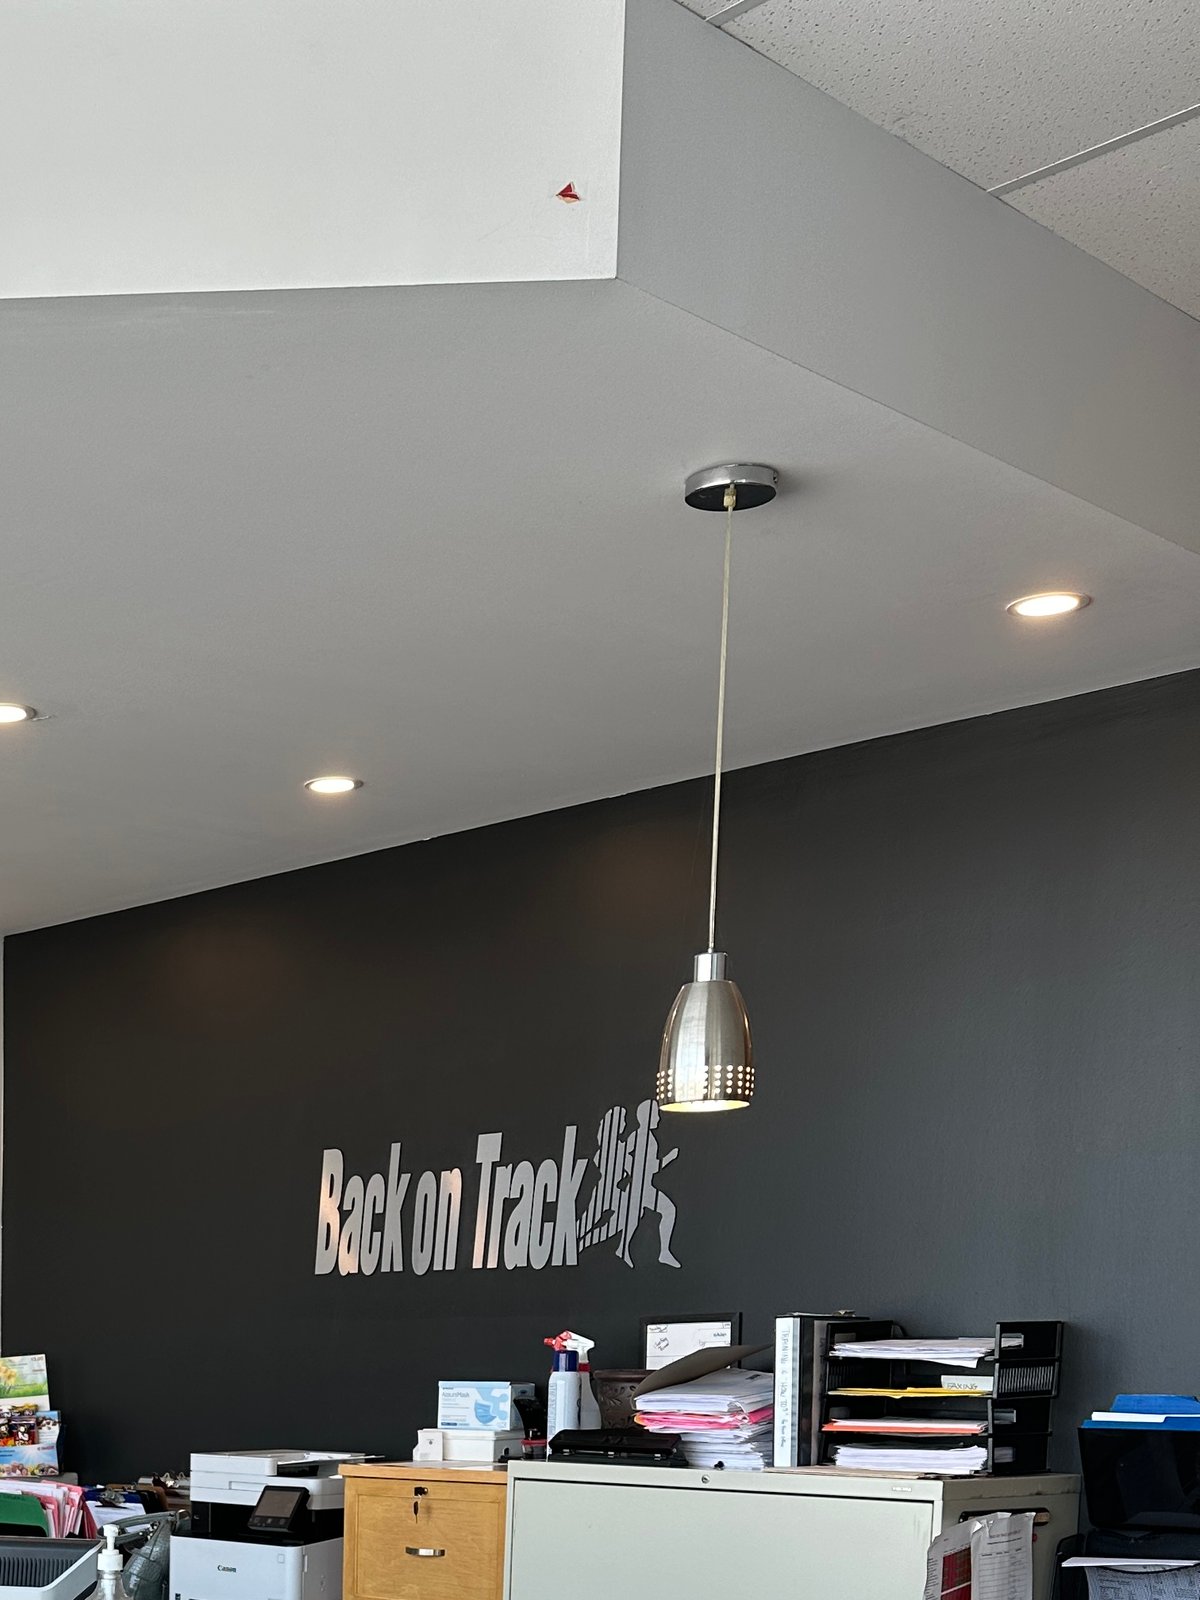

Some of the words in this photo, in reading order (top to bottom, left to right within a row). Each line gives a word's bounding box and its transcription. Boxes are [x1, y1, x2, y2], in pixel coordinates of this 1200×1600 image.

[315, 1142, 411, 1276] Back
[411, 1167, 462, 1276] on
[472, 1125, 588, 1271] Track
[947, 1382, 978, 1390] FAXING
[217, 1564, 237, 1573] Canon
